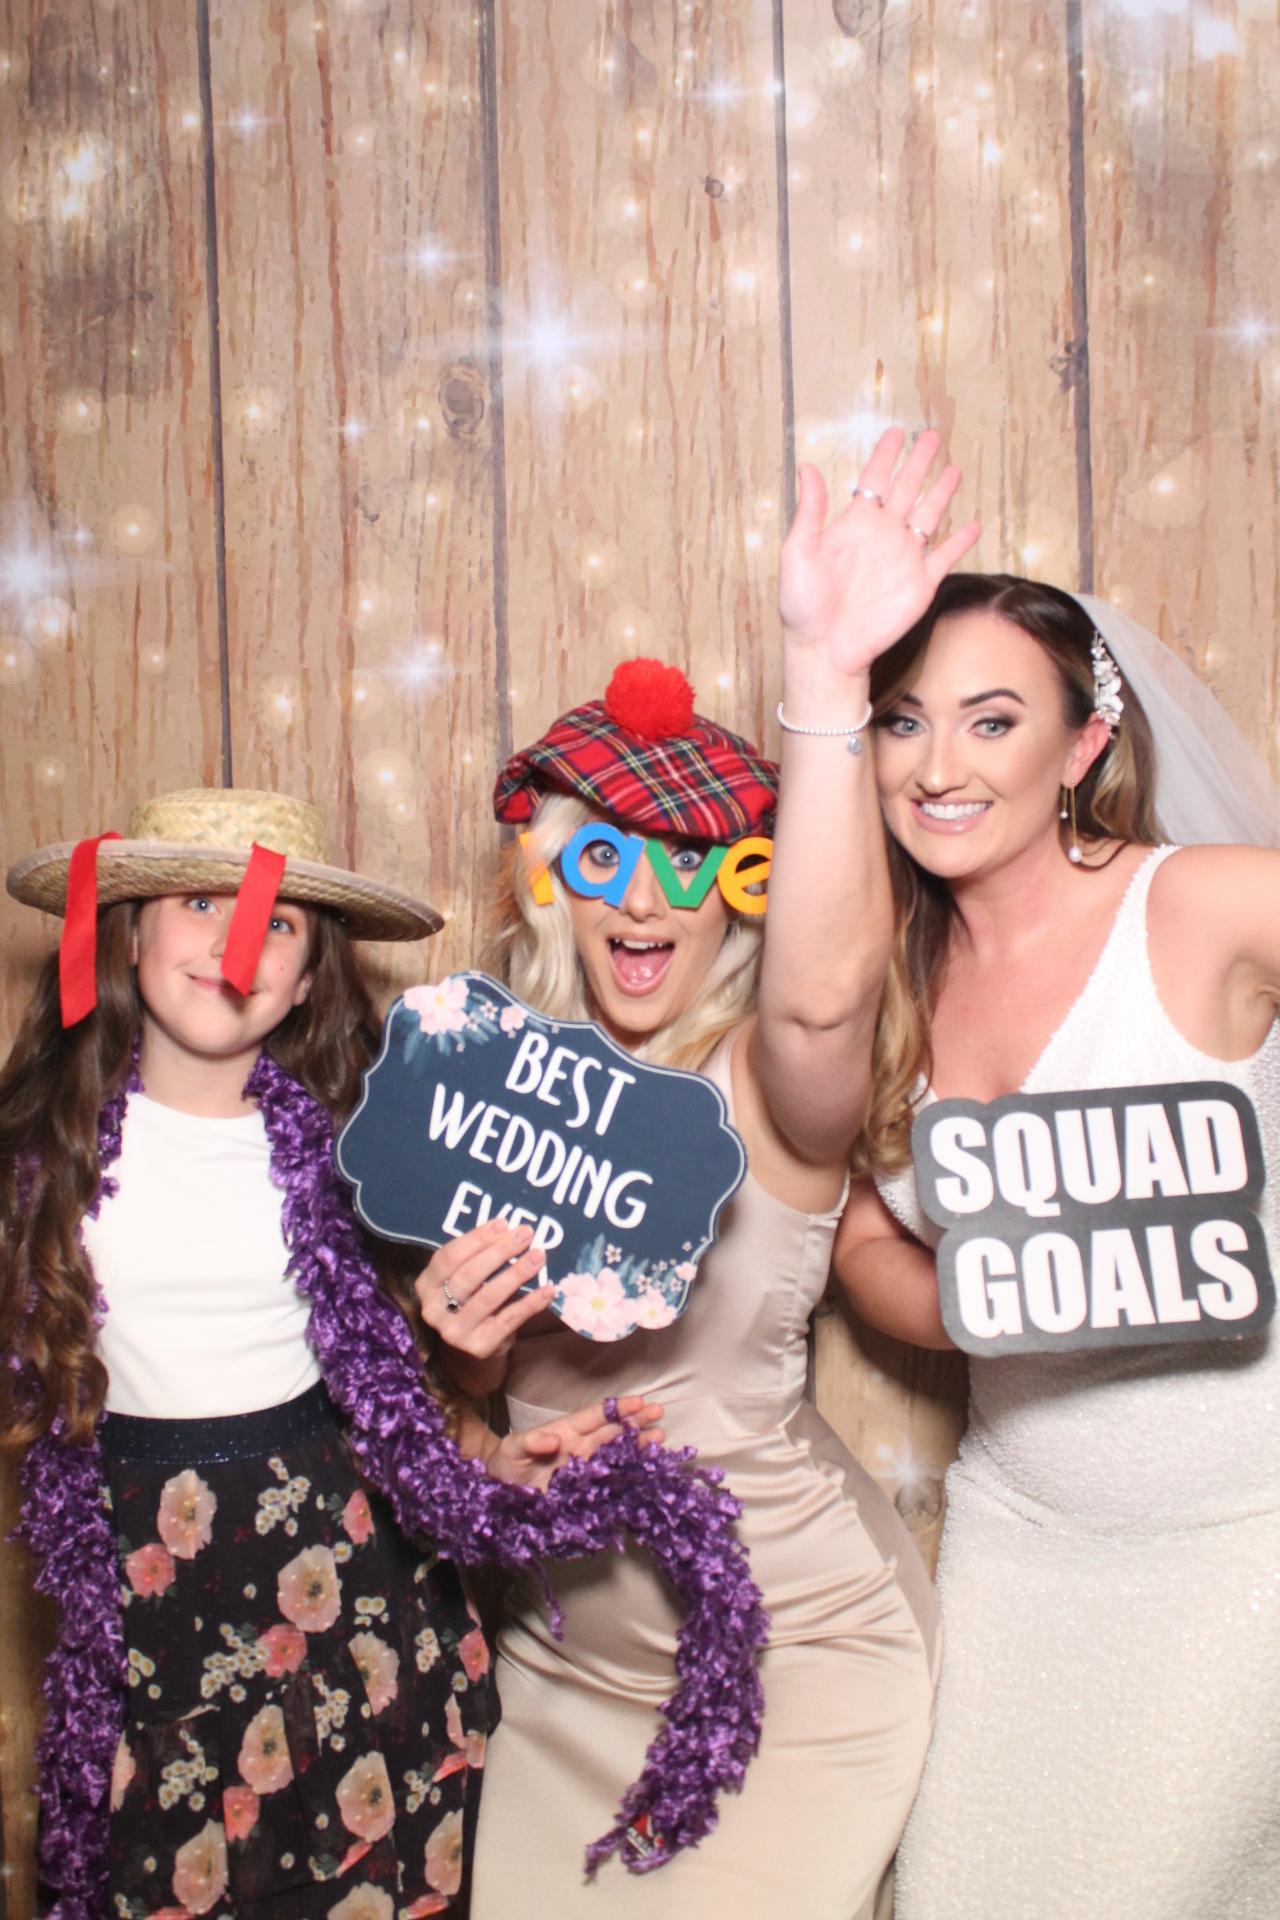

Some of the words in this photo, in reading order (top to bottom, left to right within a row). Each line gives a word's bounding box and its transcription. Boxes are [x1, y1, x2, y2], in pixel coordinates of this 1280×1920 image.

[505, 1031, 636, 1136] BEST
[428, 1082, 654, 1229] WEDDING
[929, 1099, 1248, 1217] SQUAD
[955, 1219, 1258, 1338] GOALS
